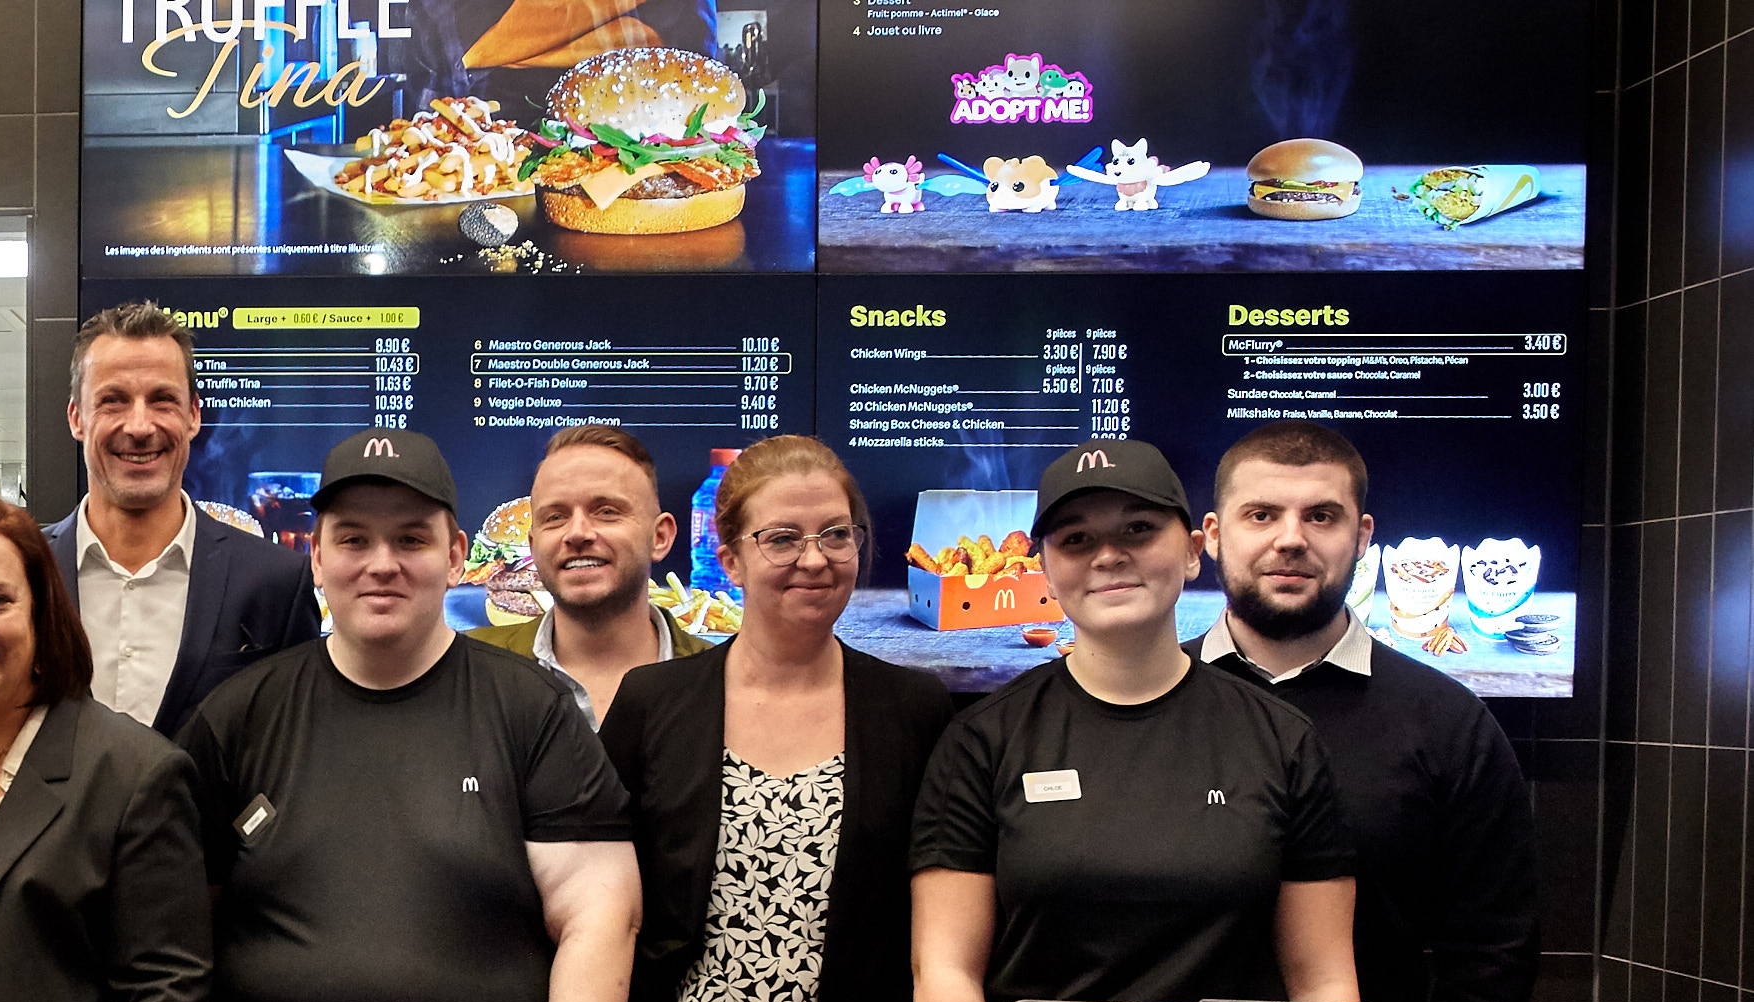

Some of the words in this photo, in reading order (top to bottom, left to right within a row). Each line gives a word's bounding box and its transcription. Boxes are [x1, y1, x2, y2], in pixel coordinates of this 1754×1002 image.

[891, 11, 923, 19] pomme
[975, 9, 999, 17] Glace
[853, 27, 860, 35] 4
[867, 26, 899, 35] Jouet
[902, 27, 916, 35] ou
[919, 26, 942, 35] livre
[142, 20, 385, 118] Tina
[954, 100, 1041, 120] ADOPT
[1044, 99, 1090, 120] ME!
[105, 246, 119, 256] Les
[120, 246, 149, 256] images
[150, 245, 165, 255] des
[213, 245, 230, 255] sont
[273, 244, 322, 255] uniquement
[330, 244, 347, 253] titre
[247, 314, 277, 325] Large
[294, 313, 310, 323] 0.60
[329, 314, 362, 323] Sauce
[380, 313, 396, 323] 1.00
[850, 305, 946, 326] Snacks
[1229, 305, 1349, 325] Desserts
[1046, 329, 1051, 339] 3
[1053, 329, 1076, 340] pièces
[1086, 329, 1091, 339] 9
[1093, 329, 1116, 340] pièces
[375, 338, 399, 353] 8.90
[474, 340, 481, 350] 6
[489, 340, 531, 350] Maestro
[533, 340, 583, 350] Generous
[585, 339, 611, 350] Jack
[742, 337, 768, 352] 10.10
[1524, 335, 1550, 350] 3.40
[851, 349, 892, 359] Chicken
[894, 349, 926, 360] Wings
[1043, 345, 1067, 360] 3.30
[1093, 345, 1116, 360] 7.90
[205, 360, 227, 370] Tina
[375, 357, 403, 372] 10.43
[474, 359, 481, 369] 7
[488, 359, 531, 370] Maestro
[533, 359, 567, 370] Double
[570, 359, 621, 370] Generous
[623, 358, 649, 370] Jack
[742, 356, 767, 371] 11.20
[1256, 356, 1303, 364] Choisissez
[1328, 357, 1360, 366] topping
[1046, 365, 1051, 374] 6
[1053, 365, 1075, 376] pièces
[1086, 365, 1091, 374] 9
[1093, 365, 1115, 376] pièces
[1256, 371, 1303, 379] Choisissez
[1390, 371, 1420, 379] Caramel
[206, 379, 236, 390] Truffle
[239, 379, 260, 389] Tina
[375, 376, 400, 391] 11.63
[474, 379, 481, 388] 8
[489, 378, 549, 388] Filet-O-Fish
[551, 378, 587, 388] Deluxe
[744, 376, 767, 391] 9.70
[851, 384, 892, 394] Chicken
[1043, 378, 1067, 393] 5.50
[1092, 378, 1113, 393] 7.10
[1228, 390, 1267, 399] Sundae
[1305, 391, 1336, 399] Caramel
[1523, 383, 1549, 398] 3.00
[206, 397, 227, 408] Tina
[229, 397, 271, 408] Chicken
[375, 395, 402, 410] 10.93
[474, 397, 481, 407] 9
[489, 397, 524, 410] Veggie
[526, 397, 562, 407] Deluxe
[741, 395, 766, 410] 9.40
[850, 402, 863, 412] 20
[865, 402, 906, 412] Chicken
[1092, 399, 1118, 414] 11.20
[1228, 408, 1280, 418] Milkshake
[1364, 410, 1398, 418] Chocolat
[1523, 404, 1548, 419] 3.50
[375, 415, 395, 428] 915
[474, 417, 485, 426] 10
[489, 416, 525, 426] Double
[527, 416, 553, 428] Royal
[555, 416, 586, 426] Crispy
[588, 416, 620, 426] Bacon
[741, 414, 767, 430] 11.00
[850, 419, 889, 431] Sharing
[891, 420, 910, 430] Box
[911, 420, 950, 430] Cheese
[952, 420, 960, 430] &
[962, 420, 1004, 430] Chicken
[1091, 416, 1119, 432] 11.00
[849, 437, 856, 447] 4
[858, 437, 911, 447] Mozzarella
[914, 437, 944, 447] sticks
